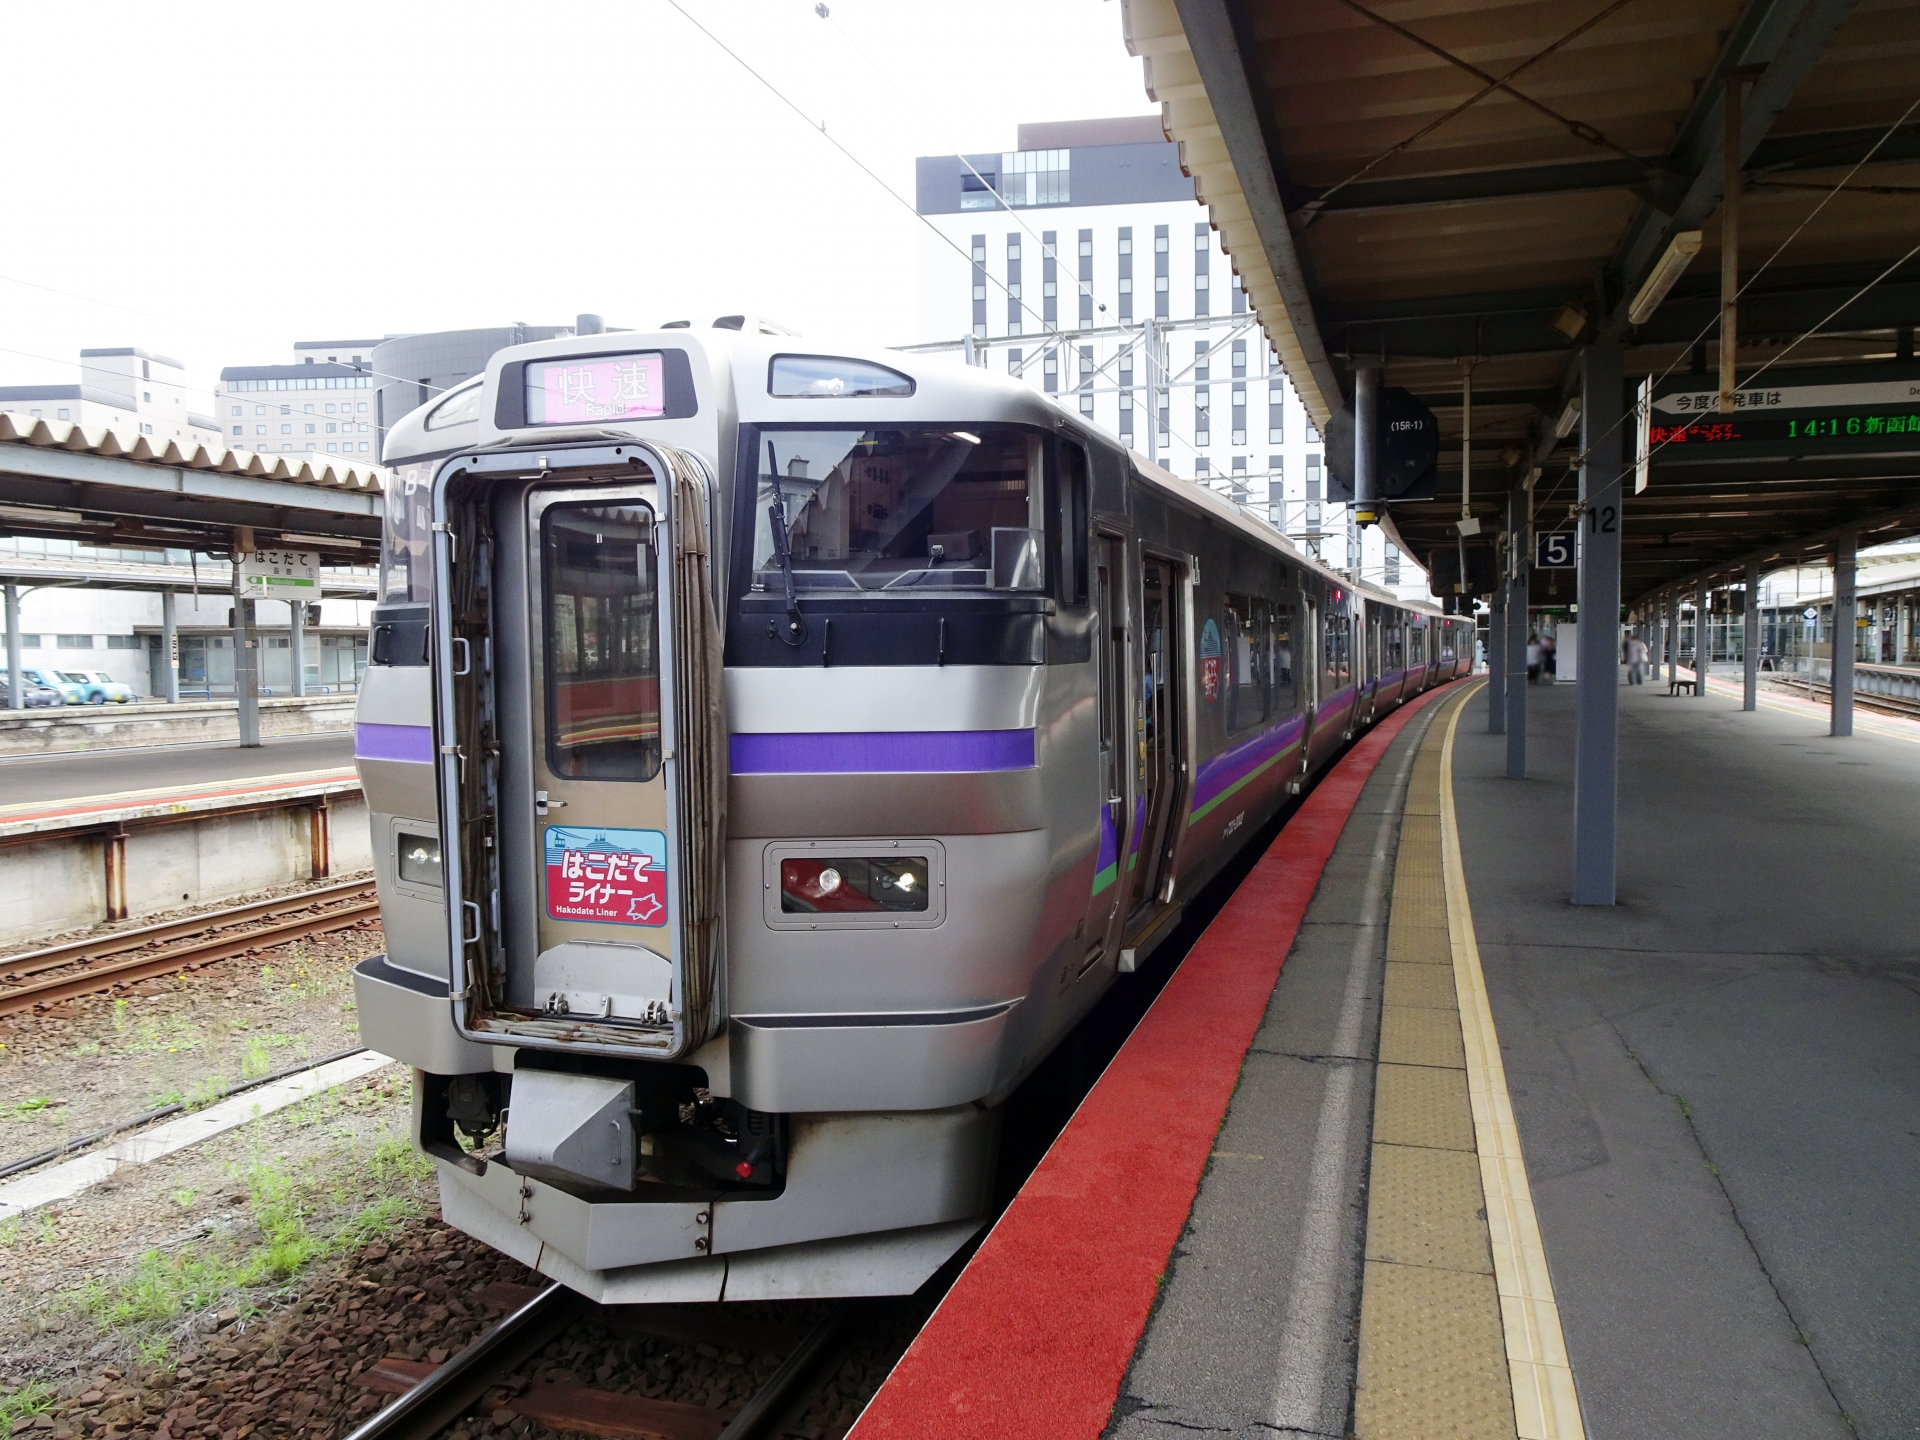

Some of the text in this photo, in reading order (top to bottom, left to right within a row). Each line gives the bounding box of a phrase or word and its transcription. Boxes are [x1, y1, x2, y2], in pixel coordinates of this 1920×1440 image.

[558, 362, 650, 405] 快速
[585, 401, 626, 419] Rapid
[1390, 420, 1423, 432] (15R-1)
[1650, 425, 1688, 444] 快速
[1788, 418, 1860, 438] 14:16
[1588, 506, 1616, 534] 12
[254, 551, 308, 566] はこだて
[1547, 535, 1568, 564] 5
[1494, 604, 1504, 614] 10
[1840, 596, 1852, 607] 10
[562, 851, 652, 883] はこだて
[569, 881, 633, 904] ライナー
[556, 905, 618, 917] Hakodate Liner
